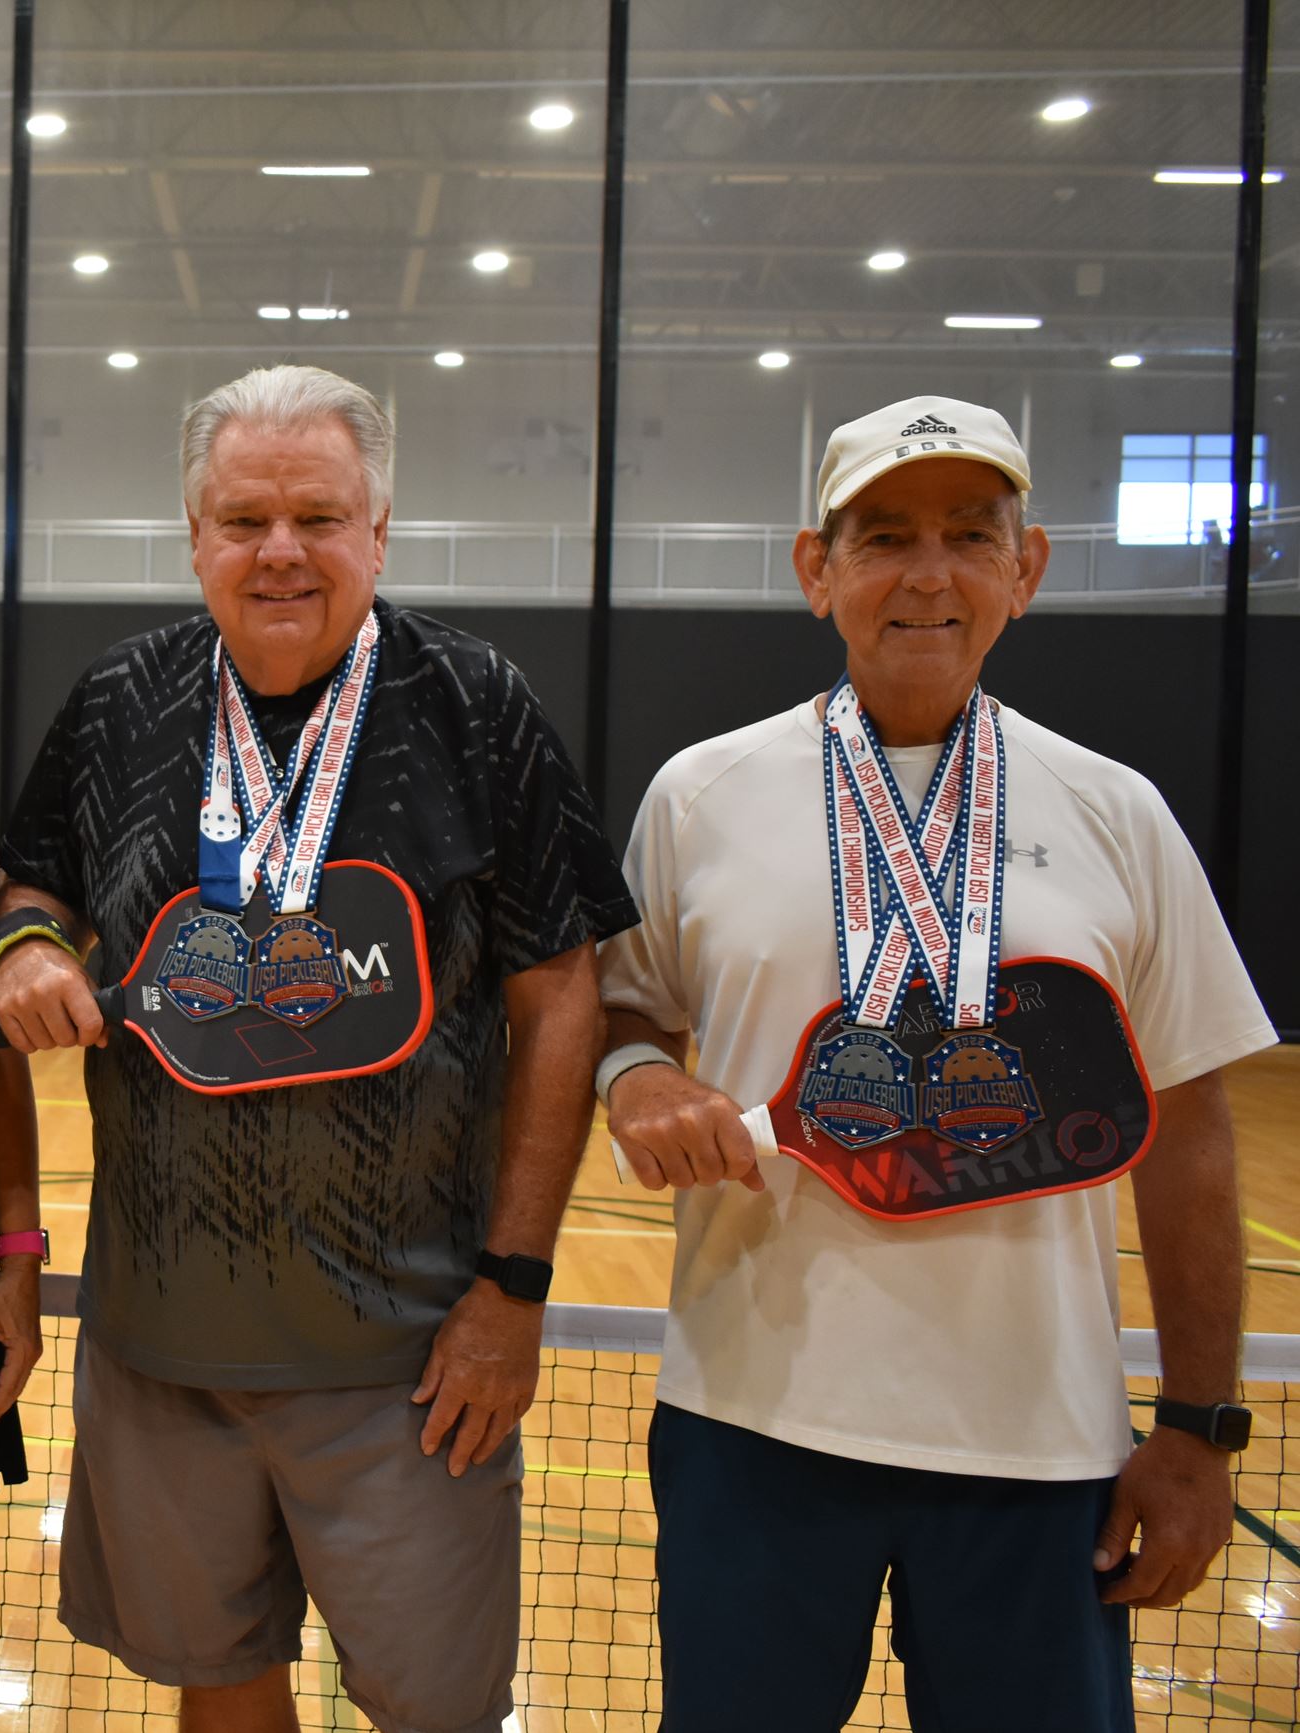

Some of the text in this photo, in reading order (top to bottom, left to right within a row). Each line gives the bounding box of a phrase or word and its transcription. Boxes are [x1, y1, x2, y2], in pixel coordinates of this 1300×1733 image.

[901, 424, 957, 437] adidas
[228, 695, 251, 747] NATIONAL
[240, 745, 265, 789] INDOOR
[978, 720, 994, 757] INDOOR
[296, 682, 359, 861] USA PICKLEBALL NATIONAL INDOOR
[856, 759, 878, 786] USA
[975, 758, 994, 810] NATIONAL
[838, 795, 860, 834] INDOOR
[864, 783, 904, 850] PICKLEBALL
[923, 823, 949, 867] INDOOR
[970, 813, 993, 877] PICKLEBALL
[842, 837, 868, 932] CHAMPIONSHIPS
[889, 849, 927, 907] NATIONAL
[968, 880, 989, 903] USA
[205, 917, 231, 930] 2022
[281, 919, 307, 931] 2022
[912, 906, 947, 953] INDOOR
[973, 916, 982, 934] USA
[161, 950, 189, 977] USA
[188, 955, 245, 998] PICKLEBALL
[254, 965, 277, 996] USA
[280, 958, 345, 988] PICKLEBALL
[151, 987, 161, 1012] USA
[863, 993, 889, 1021] USA
[850, 1035, 881, 1047] 2022
[954, 1037, 986, 1049] 2022
[804, 1073, 836, 1103] USA
[837, 1078, 912, 1120] PICKLEBALL
[926, 1085, 952, 1119] USA
[956, 1080, 1037, 1112] PICKLEBALL
